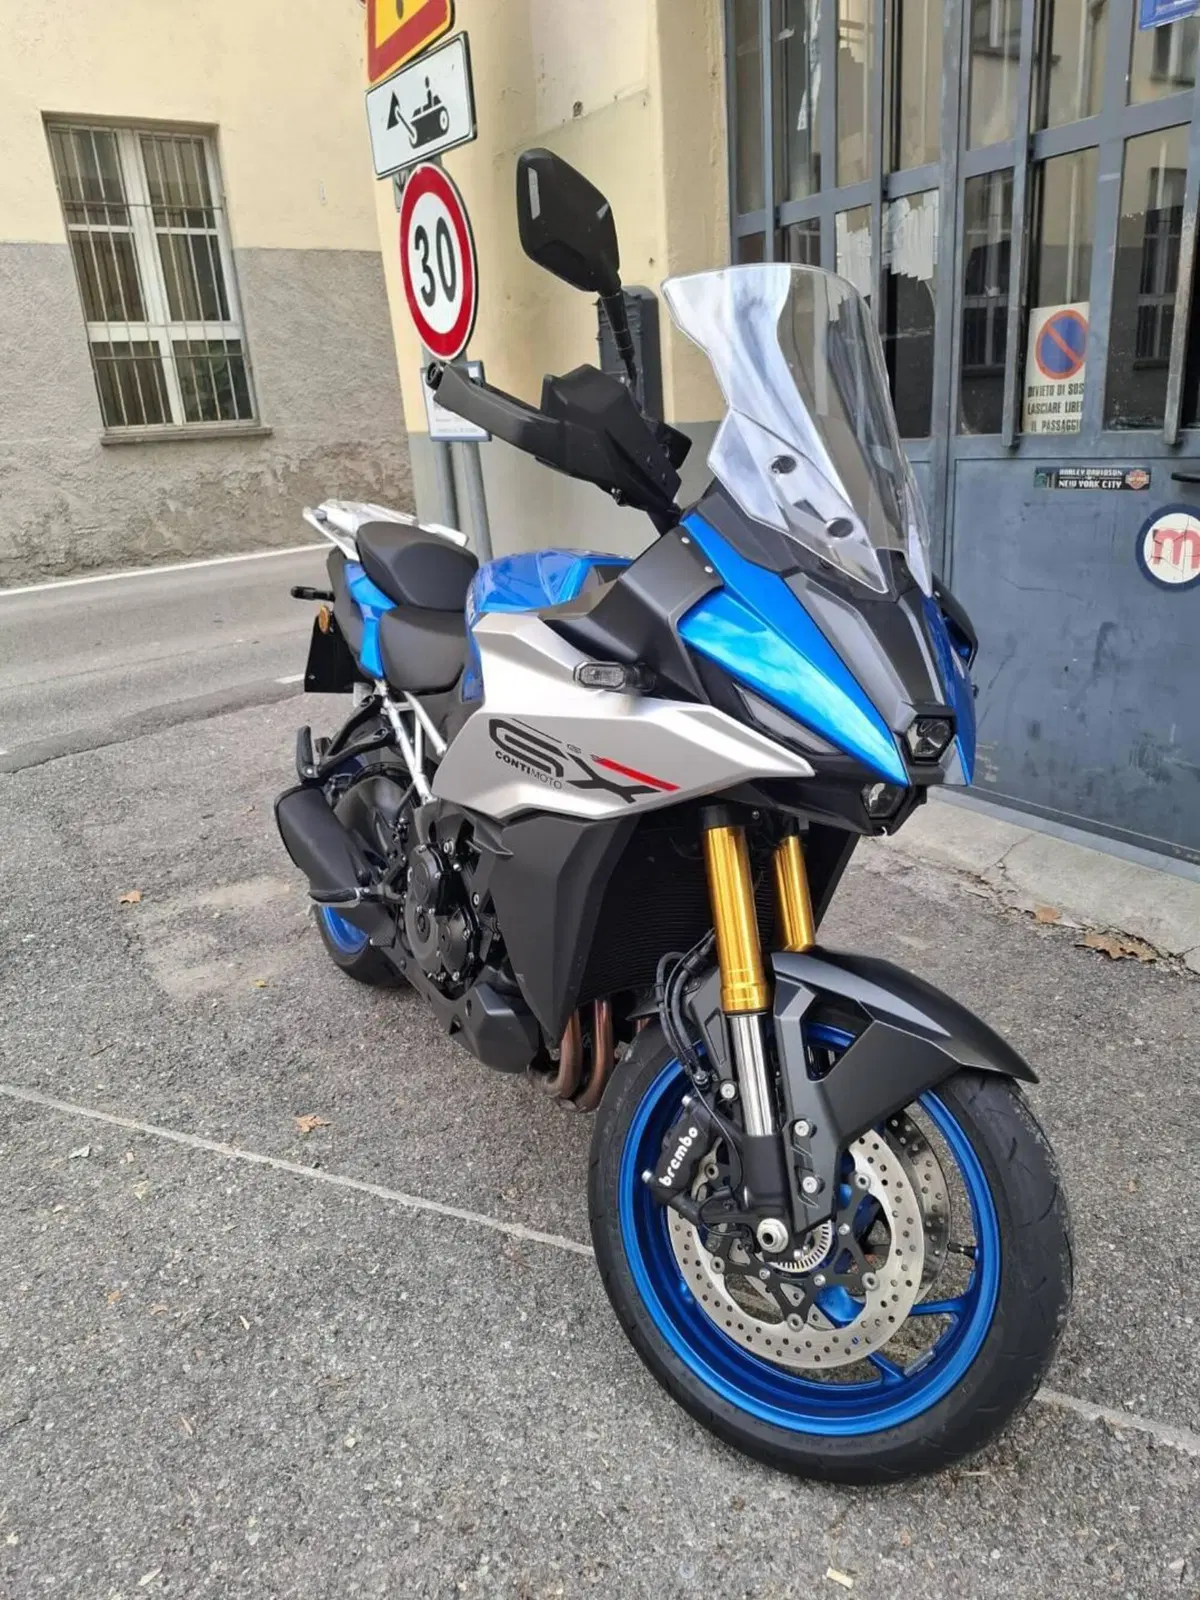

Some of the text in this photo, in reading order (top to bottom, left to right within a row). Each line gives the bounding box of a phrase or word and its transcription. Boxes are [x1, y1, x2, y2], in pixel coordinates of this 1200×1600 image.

[414, 216, 457, 308] 30
[1027, 385, 1055, 398] DIVIETO
[1057, 384, 1066, 396] DI
[1027, 402, 1061, 416] LASCIARE
[1059, 480, 1122, 489] NEW YORK CITY
[495, 750, 563, 790] CONTIMOTO
[658, 1126, 698, 1187] brembo
